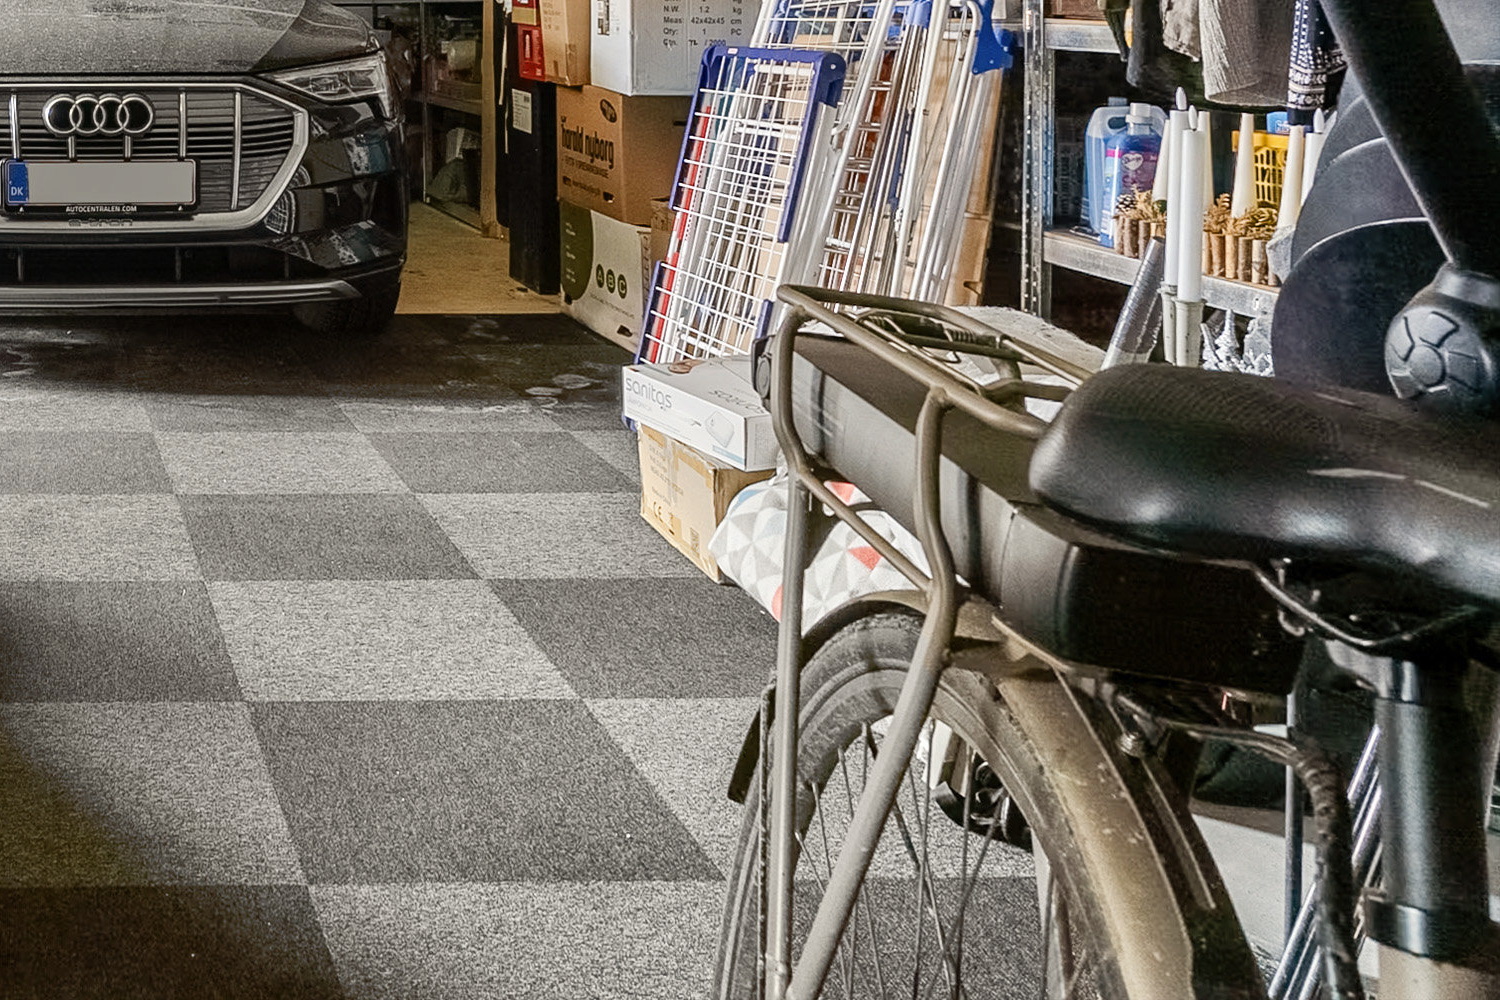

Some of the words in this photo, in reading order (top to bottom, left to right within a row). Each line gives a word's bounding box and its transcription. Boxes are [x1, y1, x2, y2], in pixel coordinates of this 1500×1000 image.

[732, 6, 742, 15] kg
[585, 131, 615, 170] nyborg
[10, 186, 24, 196] DK
[65, 205, 137, 213] AUTOCENTRALEN.COM
[625, 377, 672, 409] sanitas
